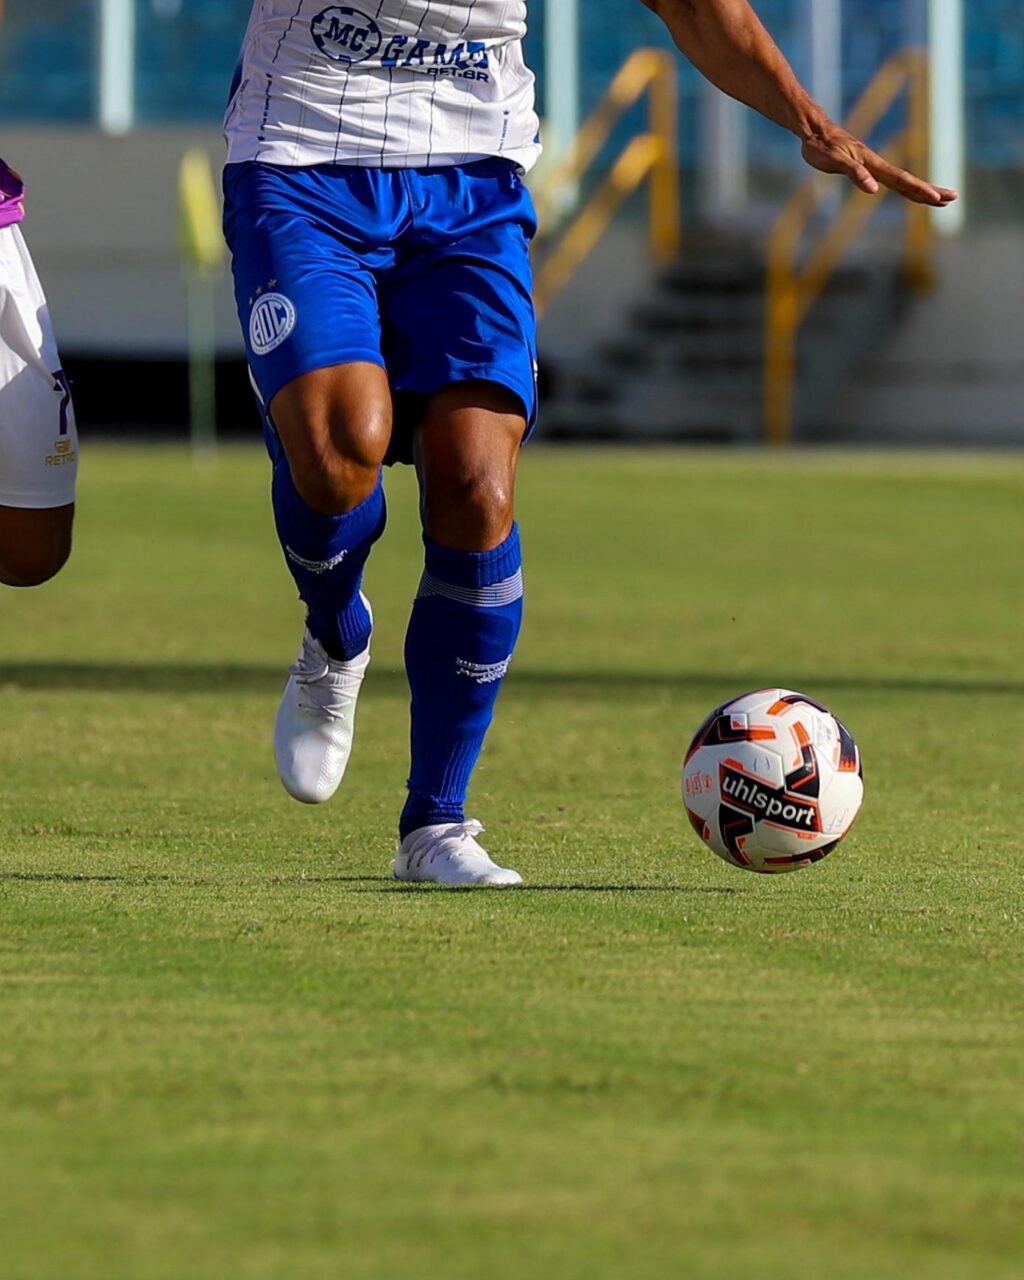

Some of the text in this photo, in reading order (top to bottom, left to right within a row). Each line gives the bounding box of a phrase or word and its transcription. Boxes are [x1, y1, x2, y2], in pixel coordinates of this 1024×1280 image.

[323, 16, 370, 52] MC
[251, 300, 287, 347] ADC
[722, 774, 816, 827] uhlsport
